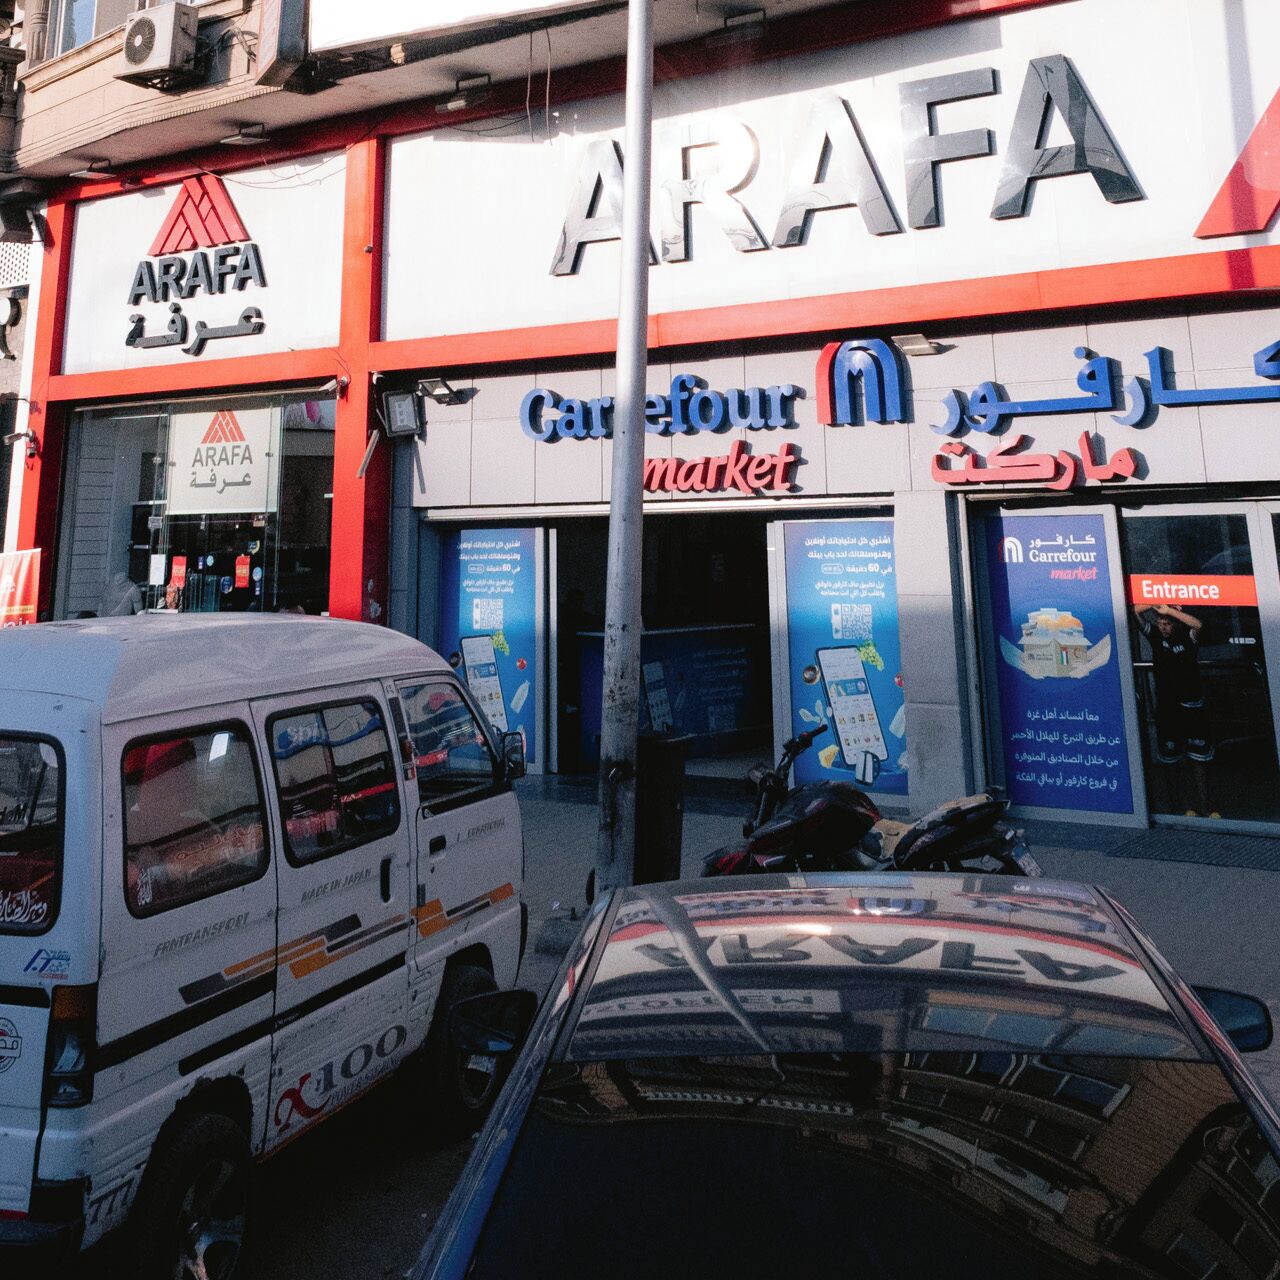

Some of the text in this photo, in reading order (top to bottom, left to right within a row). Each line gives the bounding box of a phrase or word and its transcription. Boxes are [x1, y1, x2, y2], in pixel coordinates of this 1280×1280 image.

[549, 54, 1148, 276] ARAFA
[127, 243, 269, 305] ARAFA
[125, 302, 266, 357] عرفة
[519, 373, 795, 442] Carefour
[192, 444, 253, 468] ARAFA
[643, 440, 797, 494] market
[931, 430, 1136, 490] ماركت
[189, 467, 252, 494] عرفة
[1029, 533, 1096, 548] كارفور
[1029, 549, 1097, 563] Carrefour
[868, 563, 880, 573] 60
[1050, 567, 1098, 581] market
[1142, 579, 1220, 599] Entrance
[301, 883, 329, 903] MADE
[342, 868, 372, 890] JAPAN
